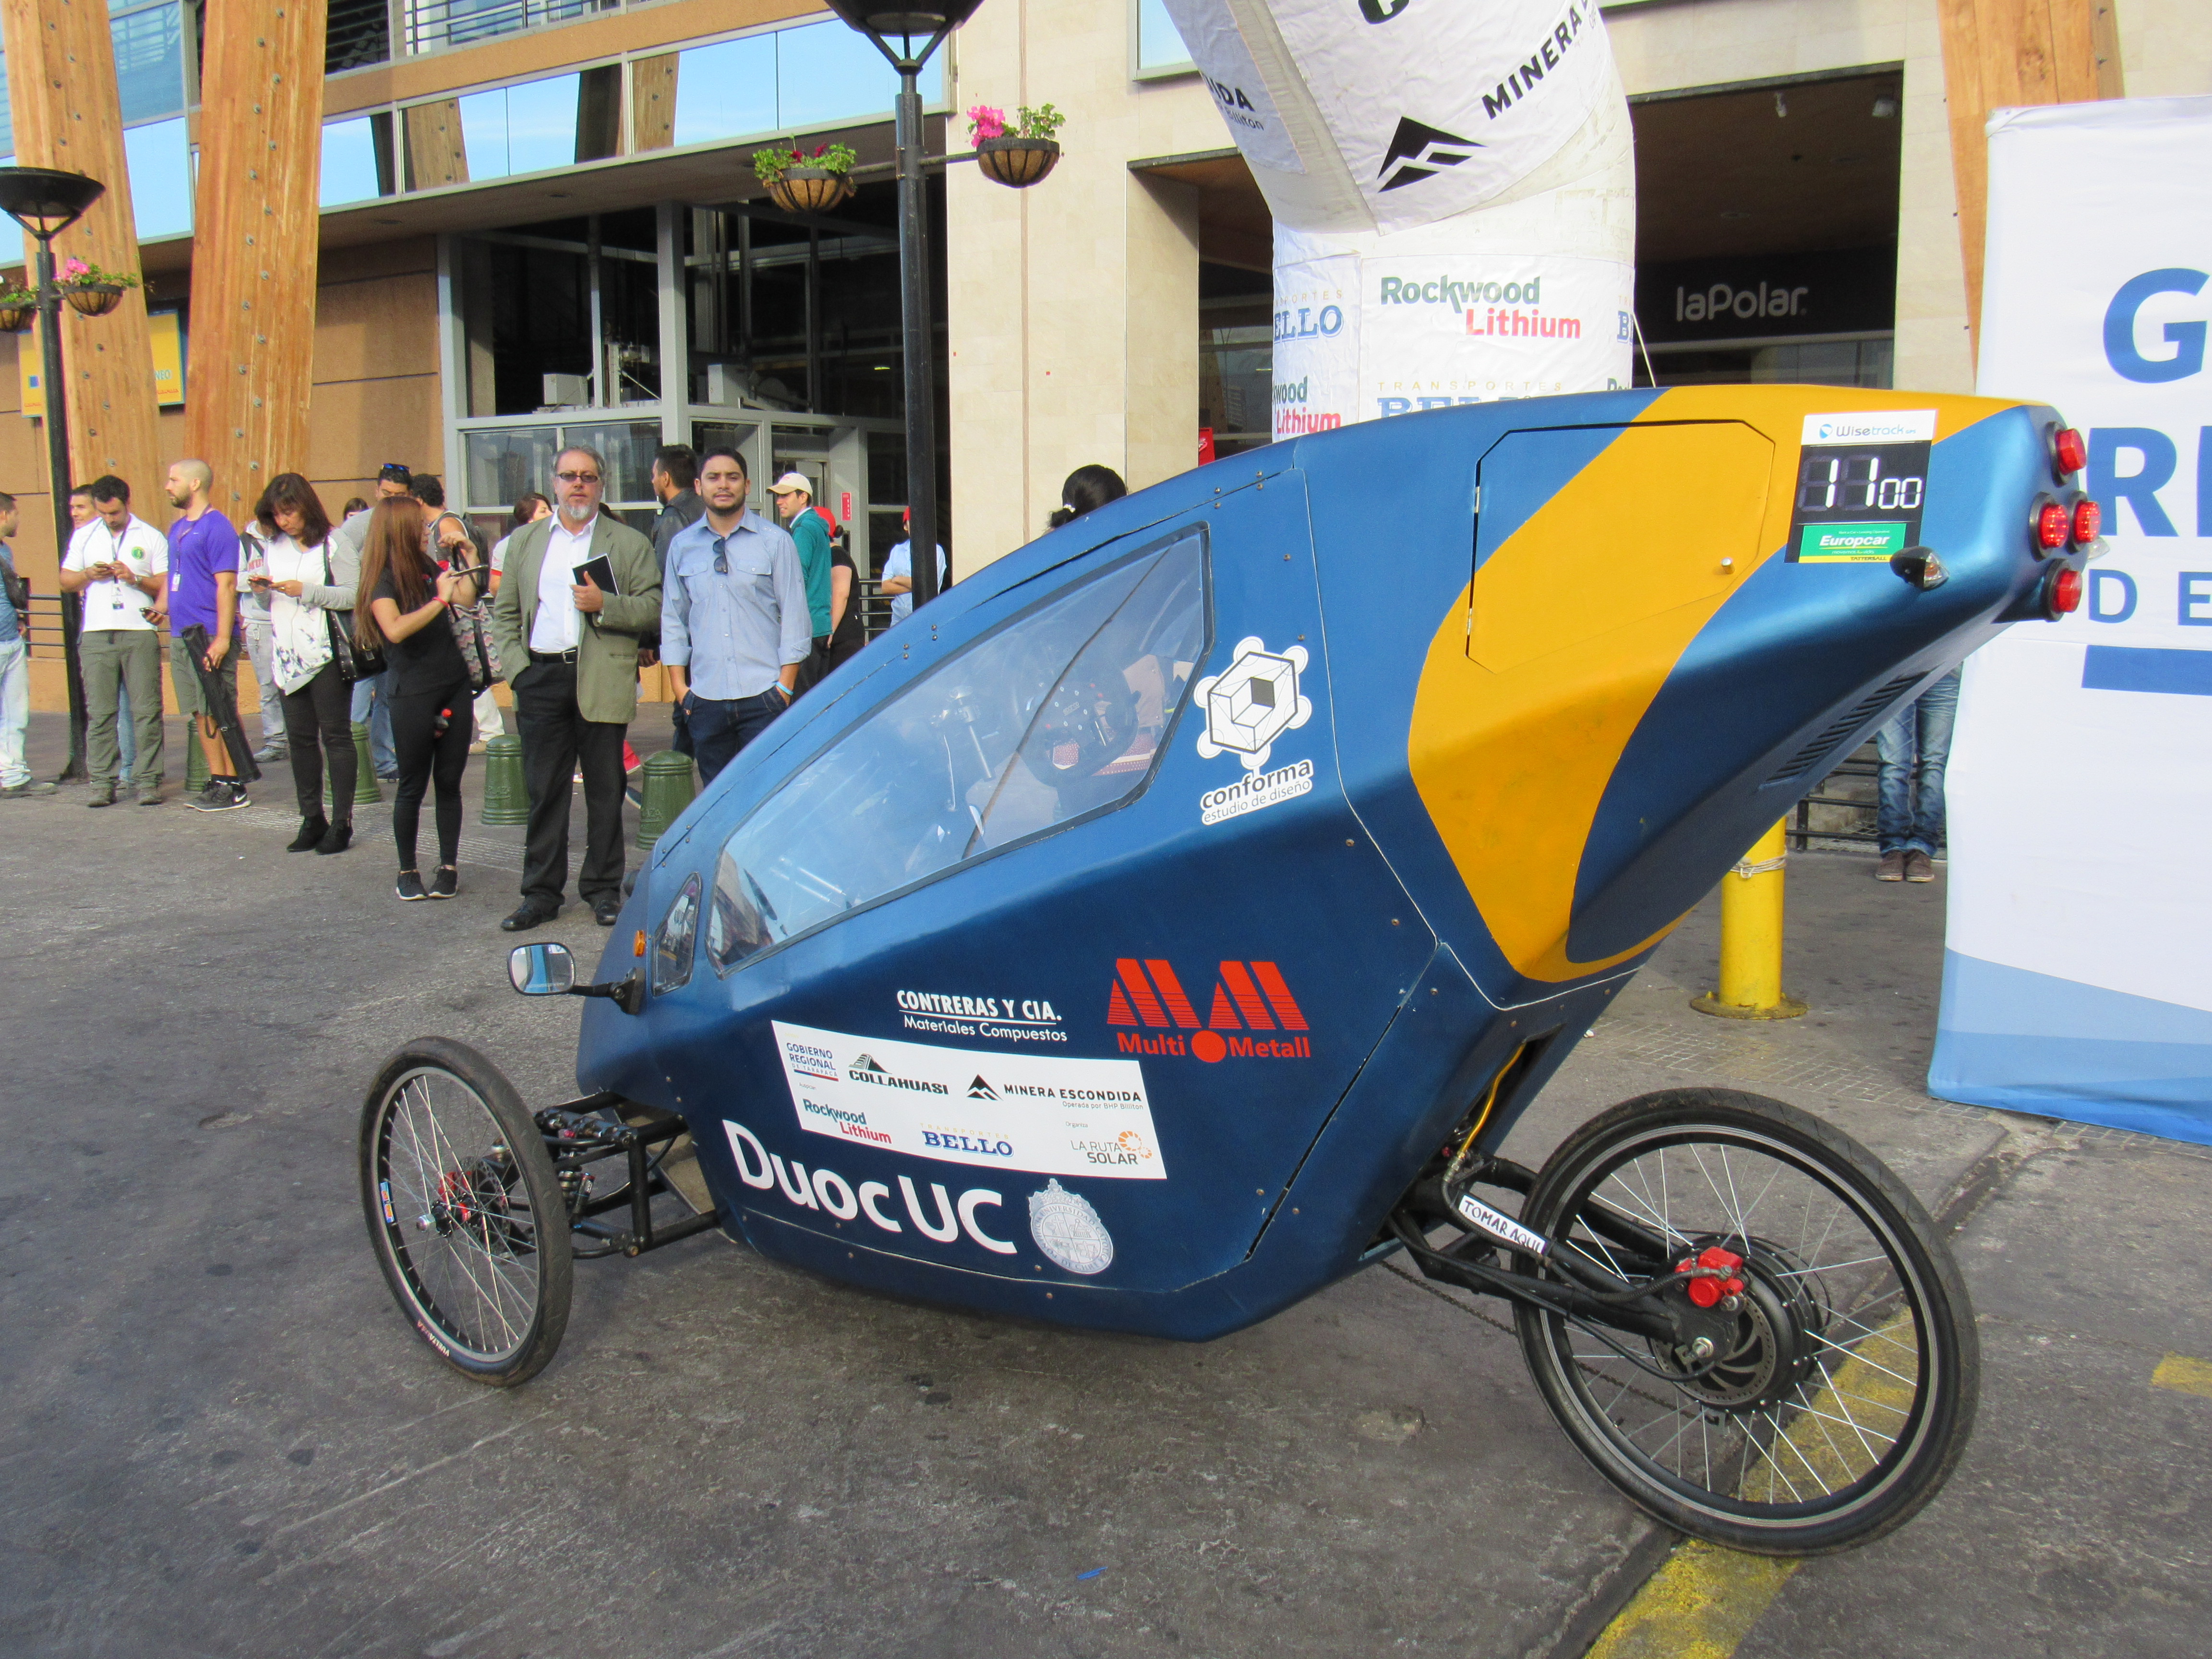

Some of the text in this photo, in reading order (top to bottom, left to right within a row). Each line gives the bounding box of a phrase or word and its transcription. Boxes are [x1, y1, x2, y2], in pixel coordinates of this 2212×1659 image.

[1482, 5, 1582, 120] MINERA
[1381, 274, 1540, 313] Rockwood
[1466, 308, 1581, 339] Lithium
[1377, 381, 1562, 392] TRANSPORTES
[1277, 407, 1341, 434] Lithium
[1836, 424, 1903, 436] Wisetrack
[1818, 535, 1890, 549] Europcar
[1202, 761, 1311, 809] conforma
[1204, 780, 1310, 822] estudio de diseño
[897, 990, 1062, 1021] CONTRERAS Y CIA.
[904, 1015, 1068, 1042] Materiales Compuestos
[786, 1042, 833, 1059] GOBIERNO
[1117, 1032, 1311, 1058] Multi Metall
[789, 1053, 837, 1070] REGIONAL
[849, 1070, 949, 1095] COLLAHUASI
[1003, 1083, 1142, 1102] MINERA ESCONDIDA
[802, 1098, 867, 1125] Rockwood
[1062, 1101, 1090, 1109] Operada
[840, 1121, 892, 1144] Lithium
[920, 1122, 1010, 1140] TRANSPORTES
[921, 1130, 1014, 1157] BELLO
[1070, 1140, 1122, 1153] LA RUTA
[1087, 1152, 1139, 1165] SOLAR
[1042, 1205, 1095, 1226] UNIVERSIDAD
[1464, 1200, 1541, 1253] TOMAR AQUI
